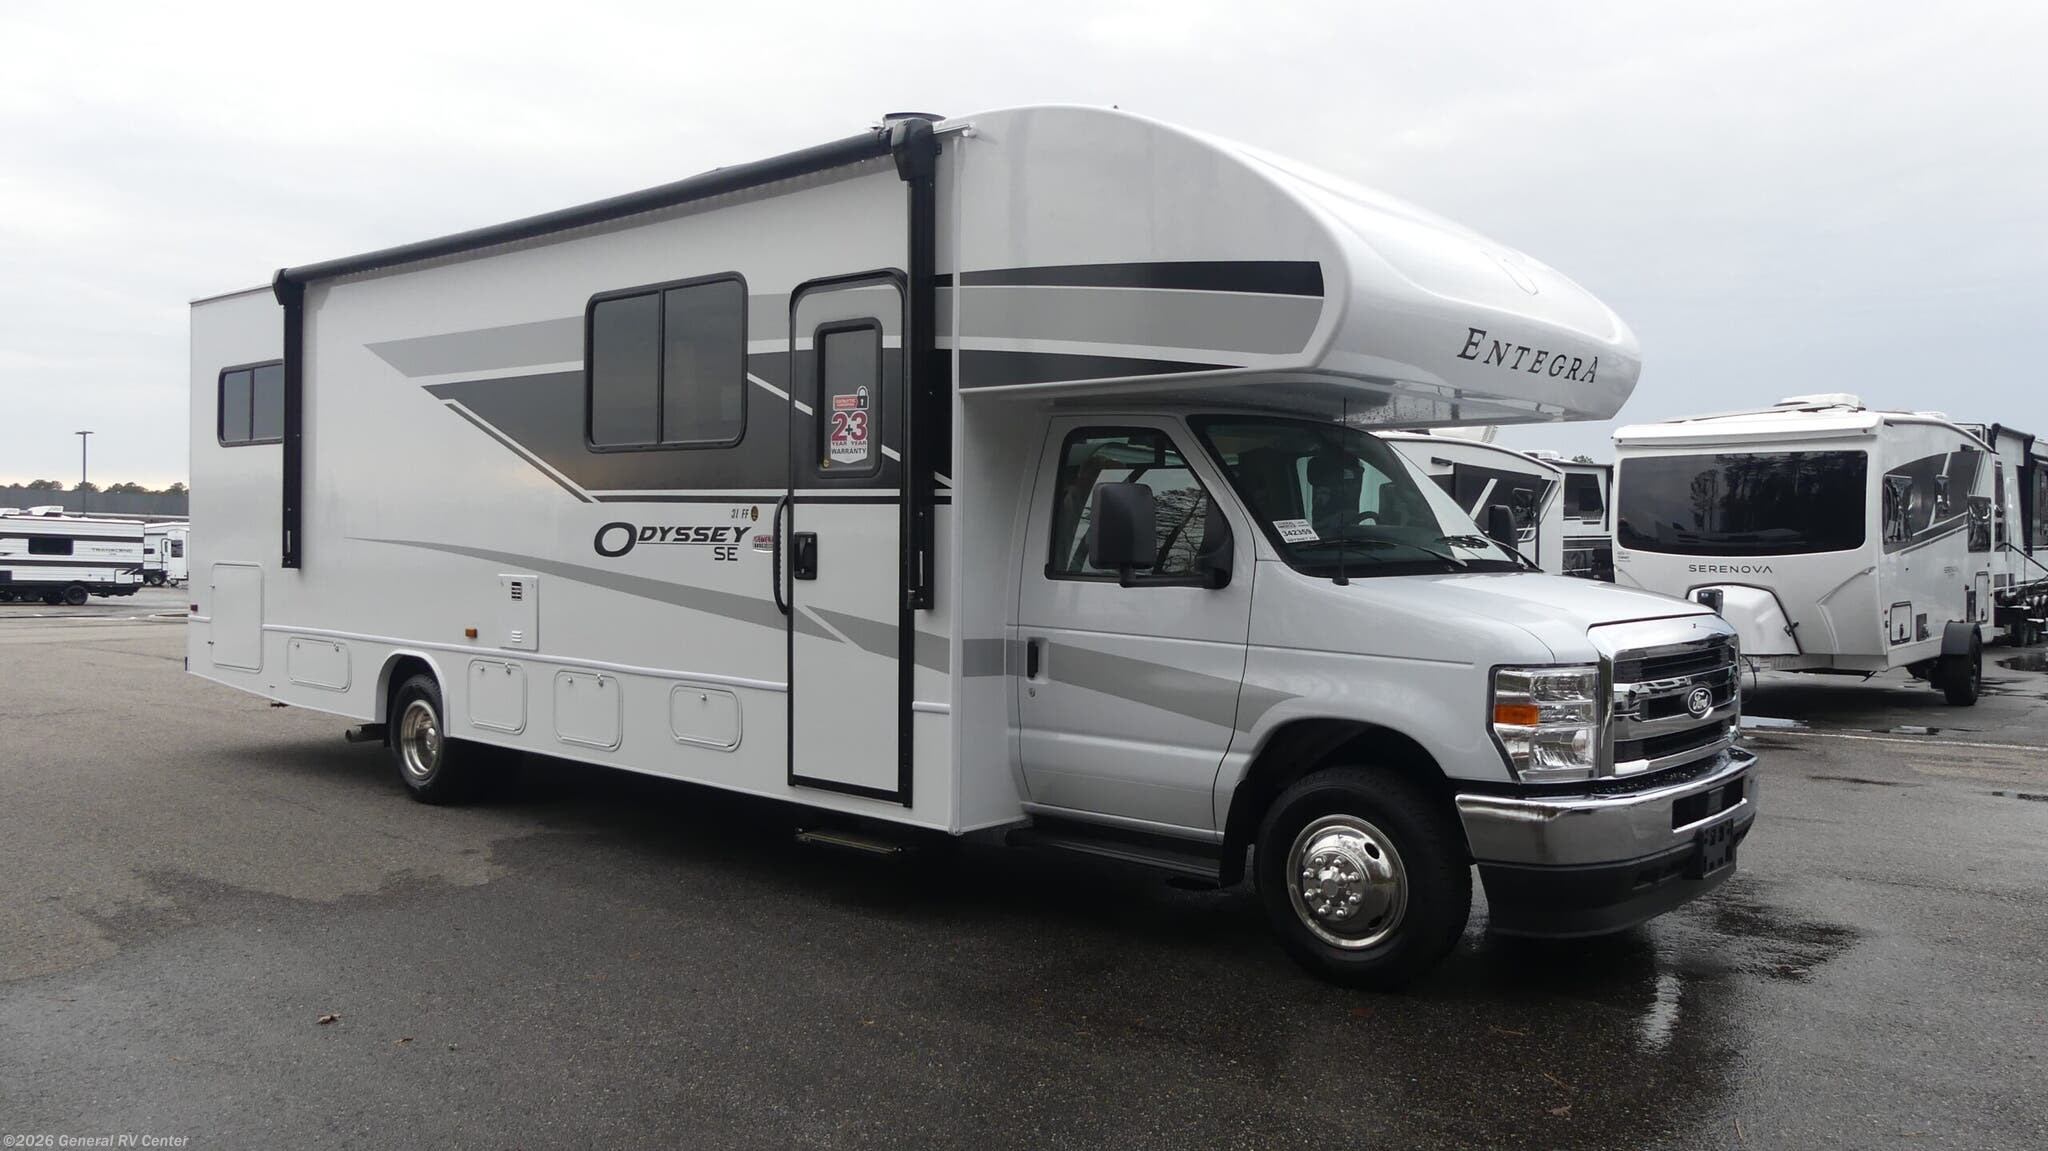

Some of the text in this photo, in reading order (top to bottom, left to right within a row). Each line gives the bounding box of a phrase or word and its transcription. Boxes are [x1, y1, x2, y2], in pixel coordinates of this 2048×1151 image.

[1457, 327, 1598, 383] ENTEGRA
[594, 521, 752, 557] ODYSSEY
[714, 546, 738, 561] SE
[1688, 564, 1773, 574] SERENOVA
[1692, 691, 1709, 710] Ford
